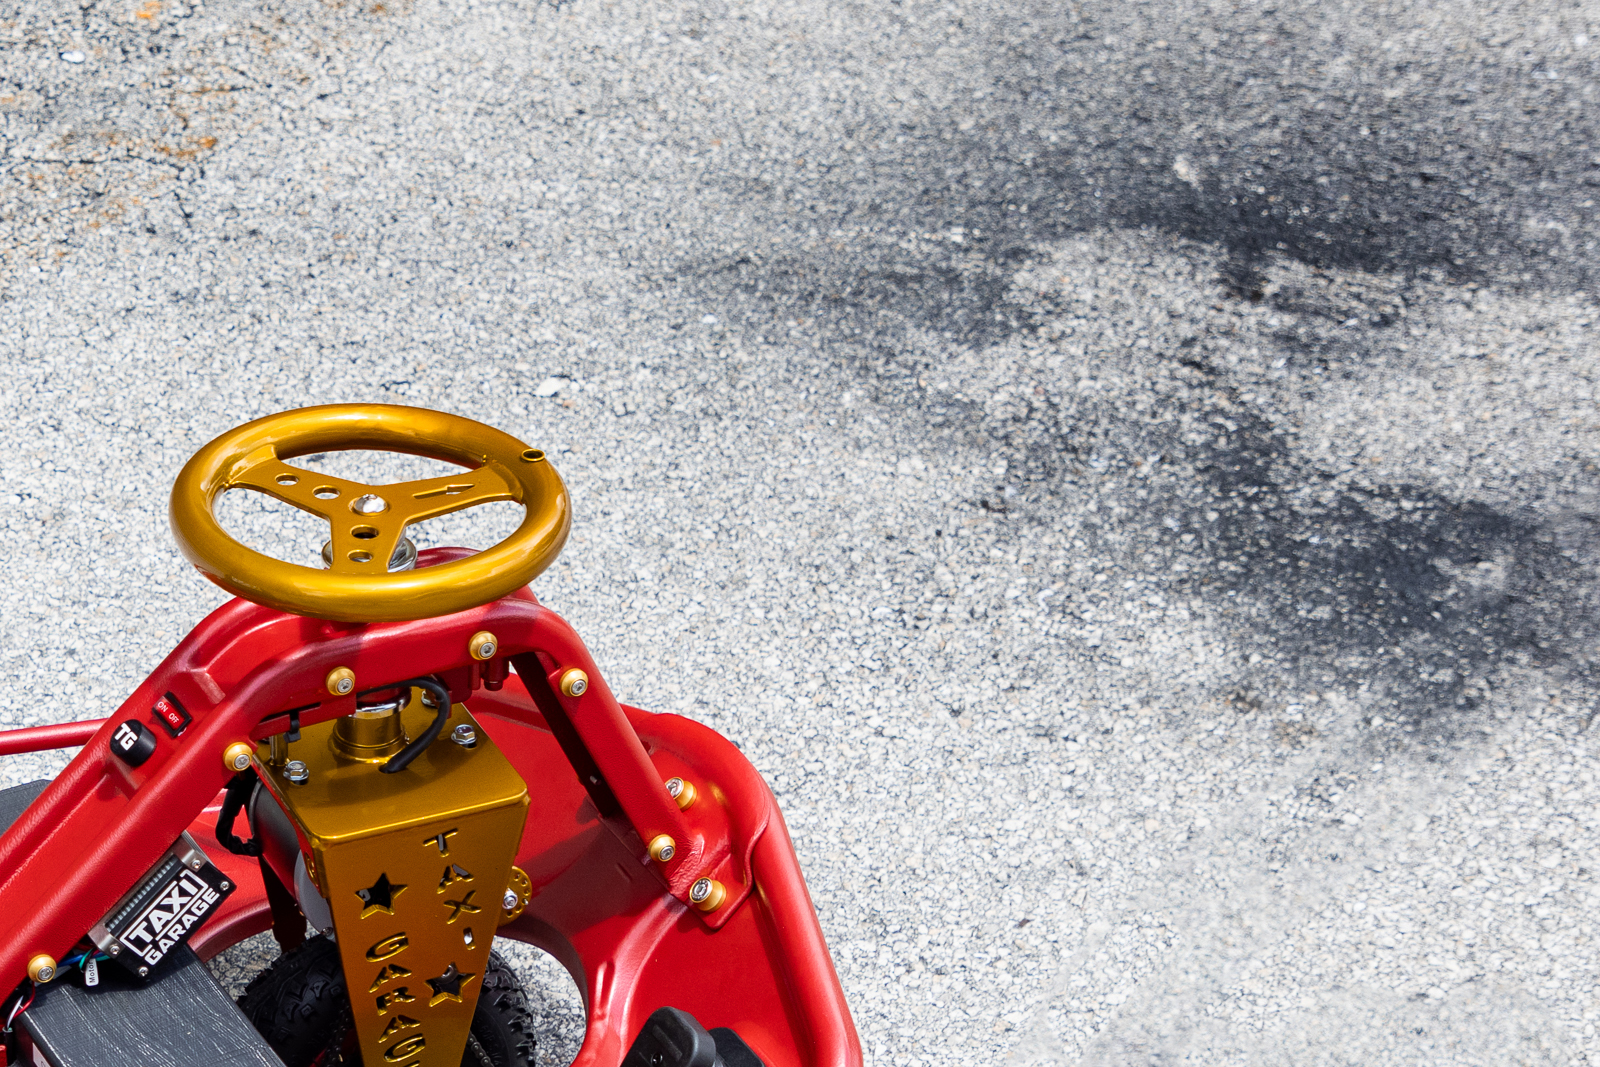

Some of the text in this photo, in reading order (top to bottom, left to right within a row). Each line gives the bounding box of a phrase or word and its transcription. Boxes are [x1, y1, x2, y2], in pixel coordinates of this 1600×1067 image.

[157, 701, 169, 713] ON
[168, 712, 180, 724] OFF
[114, 722, 138, 751] TG
[128, 877, 200, 944] TAXI
[422, 827, 482, 950] TAXI
[144, 890, 220, 966] GARAGE
